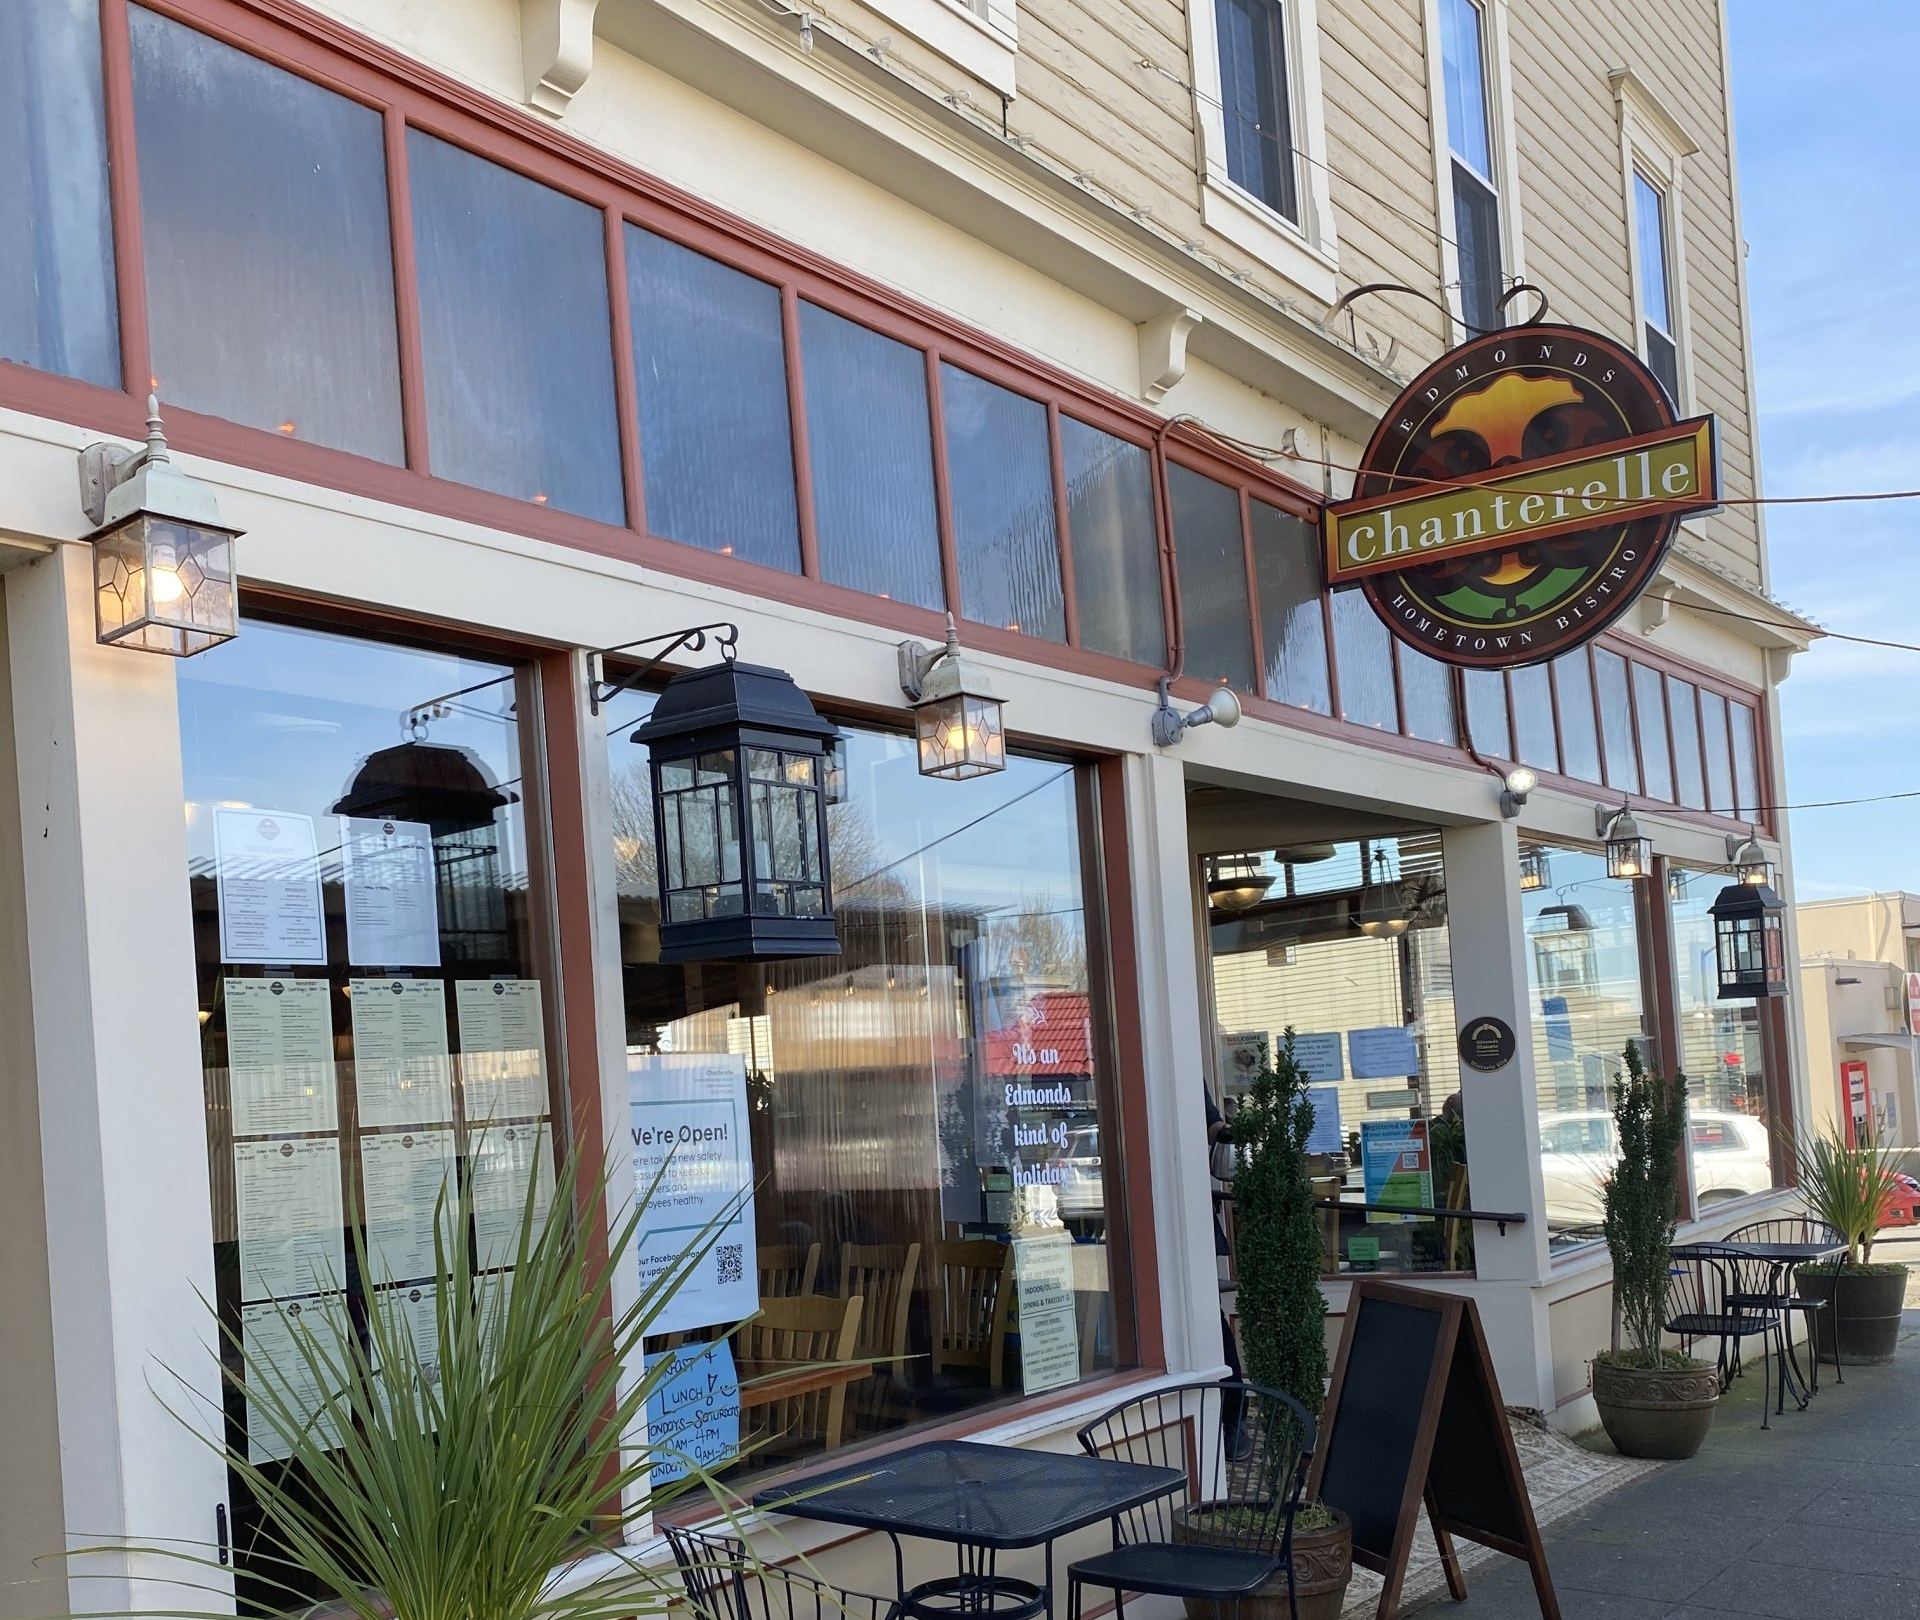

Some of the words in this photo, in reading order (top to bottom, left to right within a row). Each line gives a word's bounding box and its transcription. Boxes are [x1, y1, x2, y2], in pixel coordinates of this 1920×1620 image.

[1400, 344, 1617, 433] EDMONDS
[1346, 451, 1690, 563] chanterelle
[1391, 593, 1534, 651] HOMETOWN
[1555, 547, 1637, 631] BISTRO
[1012, 1042, 1037, 1065] It's
[1040, 1049, 1061, 1064] an
[1004, 1082, 1071, 1106] Edmonds
[678, 1122, 728, 1146] Open!
[1013, 1121, 1049, 1147] kind
[1051, 1121, 1068, 1149] of
[1362, 1120, 1399, 1131] Registered
[632, 1156, 649, 1166] e're
[650, 1153, 677, 1166] takig
[678, 1154, 696, 1163] new
[696, 1150, 722, 1162] safety
[668, 1168, 677, 1178] to
[1022, 1299, 1040, 1310] DINING
[1040, 1299, 1045, 1307] &
[1045, 1294, 1065, 1306] TAKEOUT
